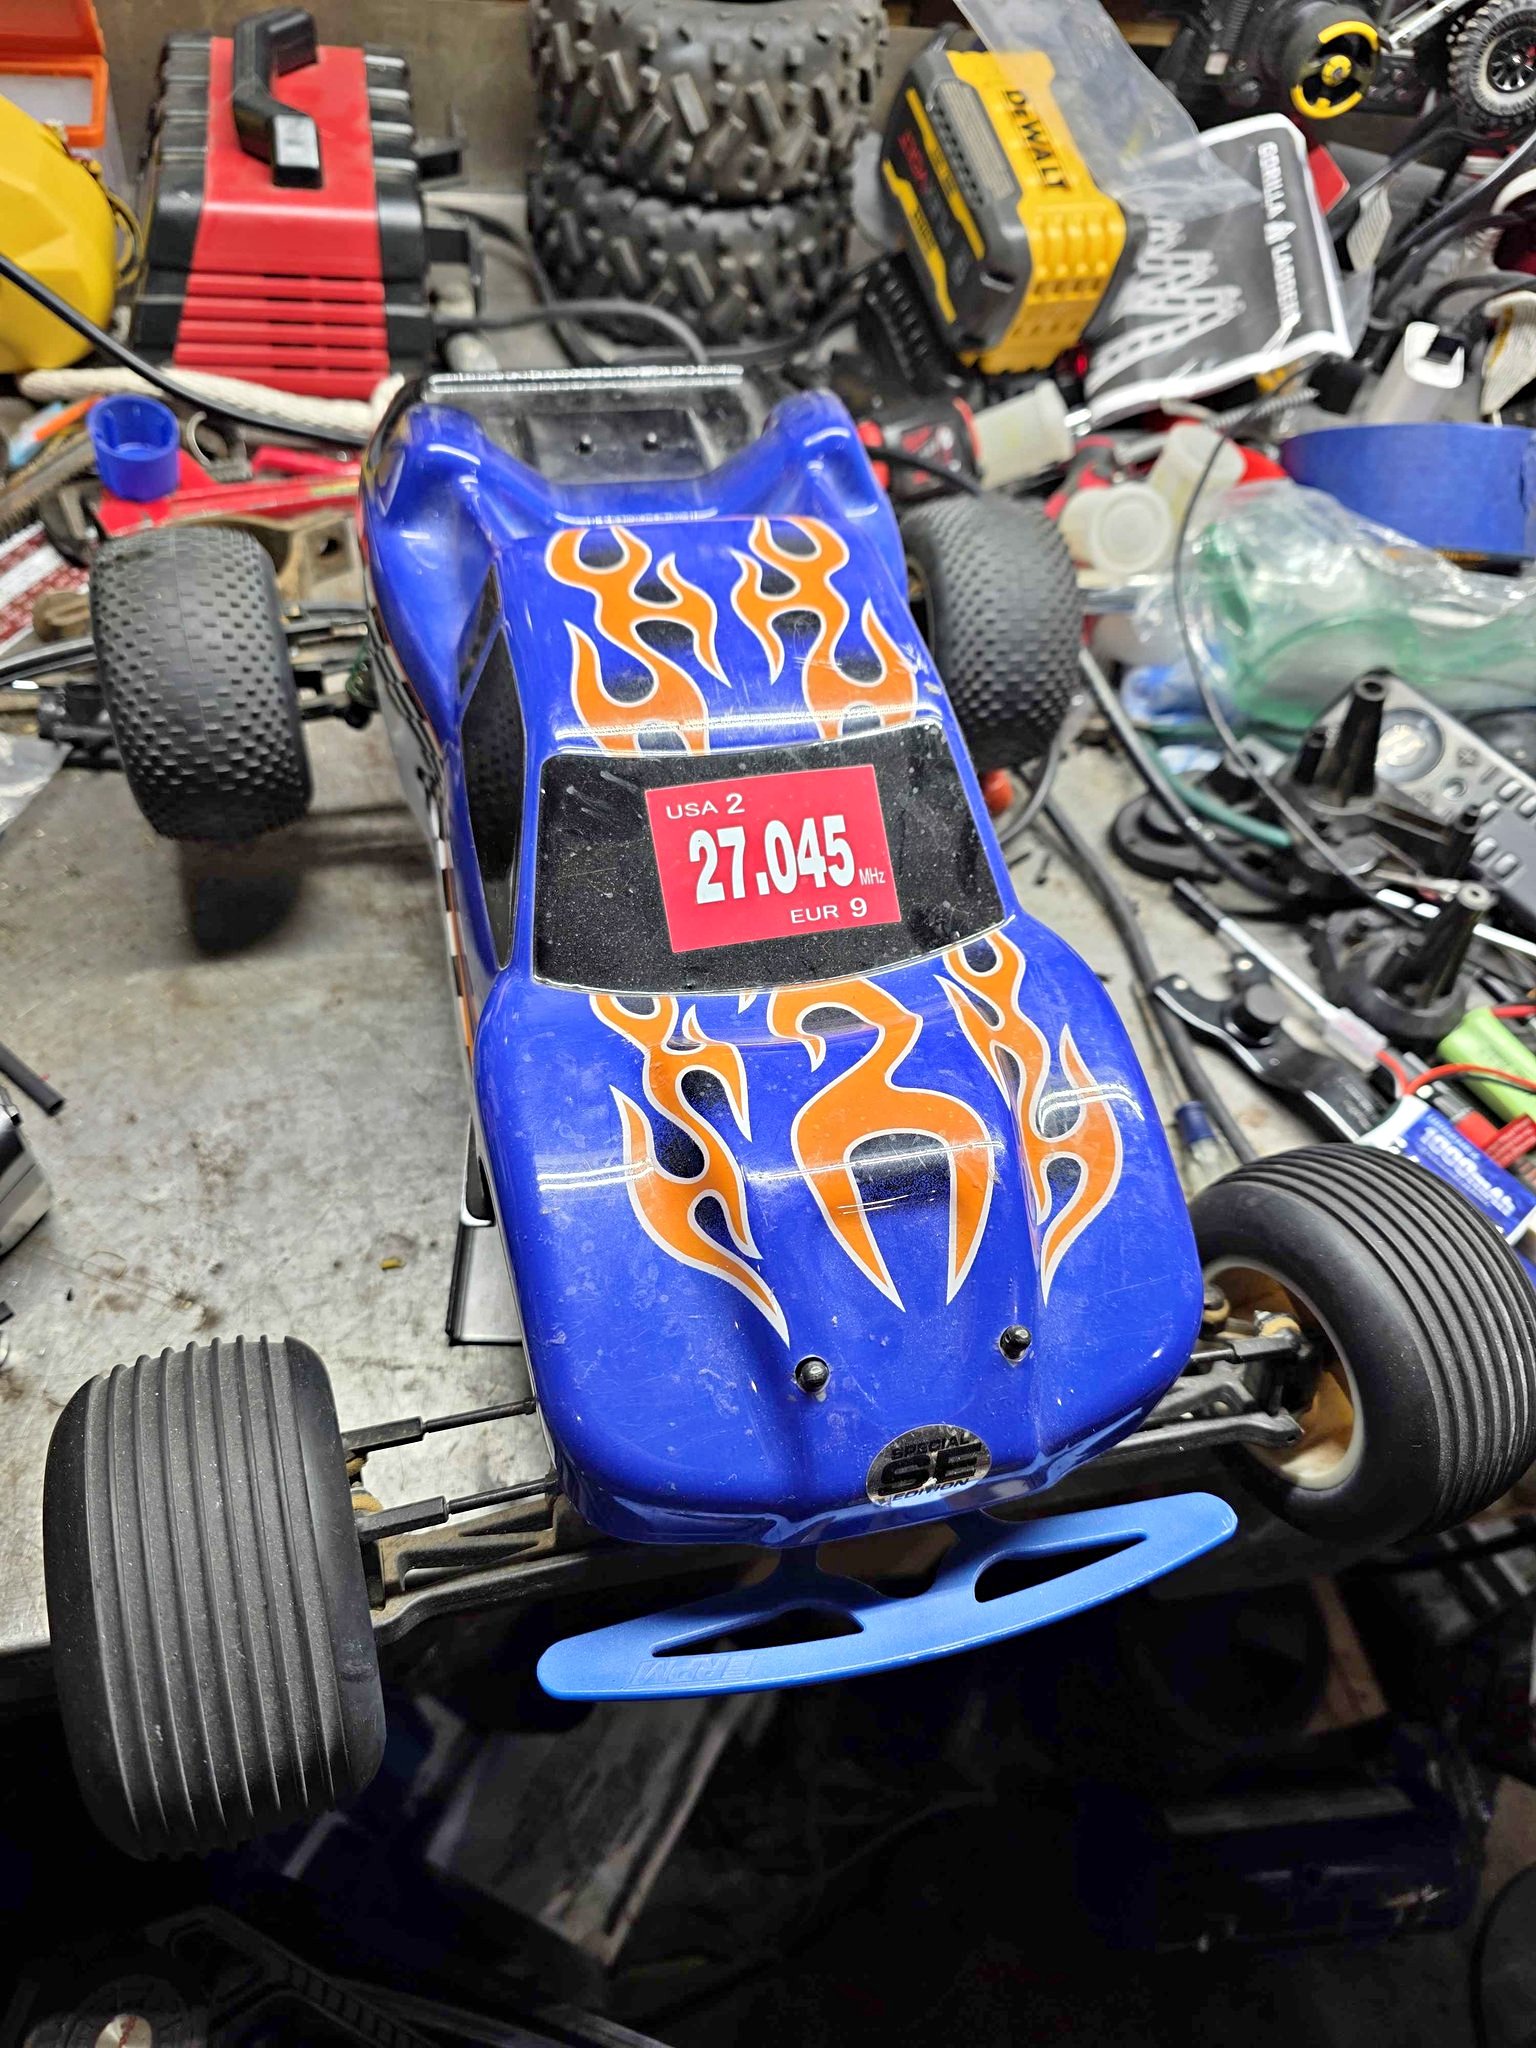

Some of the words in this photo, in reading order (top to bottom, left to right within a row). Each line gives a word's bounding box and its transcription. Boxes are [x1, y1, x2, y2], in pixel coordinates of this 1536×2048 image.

[1257, 141, 1287, 221] GORILLA
[665, 799, 719, 819] USA
[725, 792, 745, 815] 2
[688, 813, 856, 905] 27.045
[858, 867, 886, 886] MHz
[790, 904, 840, 924] EUR
[849, 897, 868, 918] 9
[877, 1440, 982, 1497] SE
[889, 1434, 972, 1461] SPECIAL
